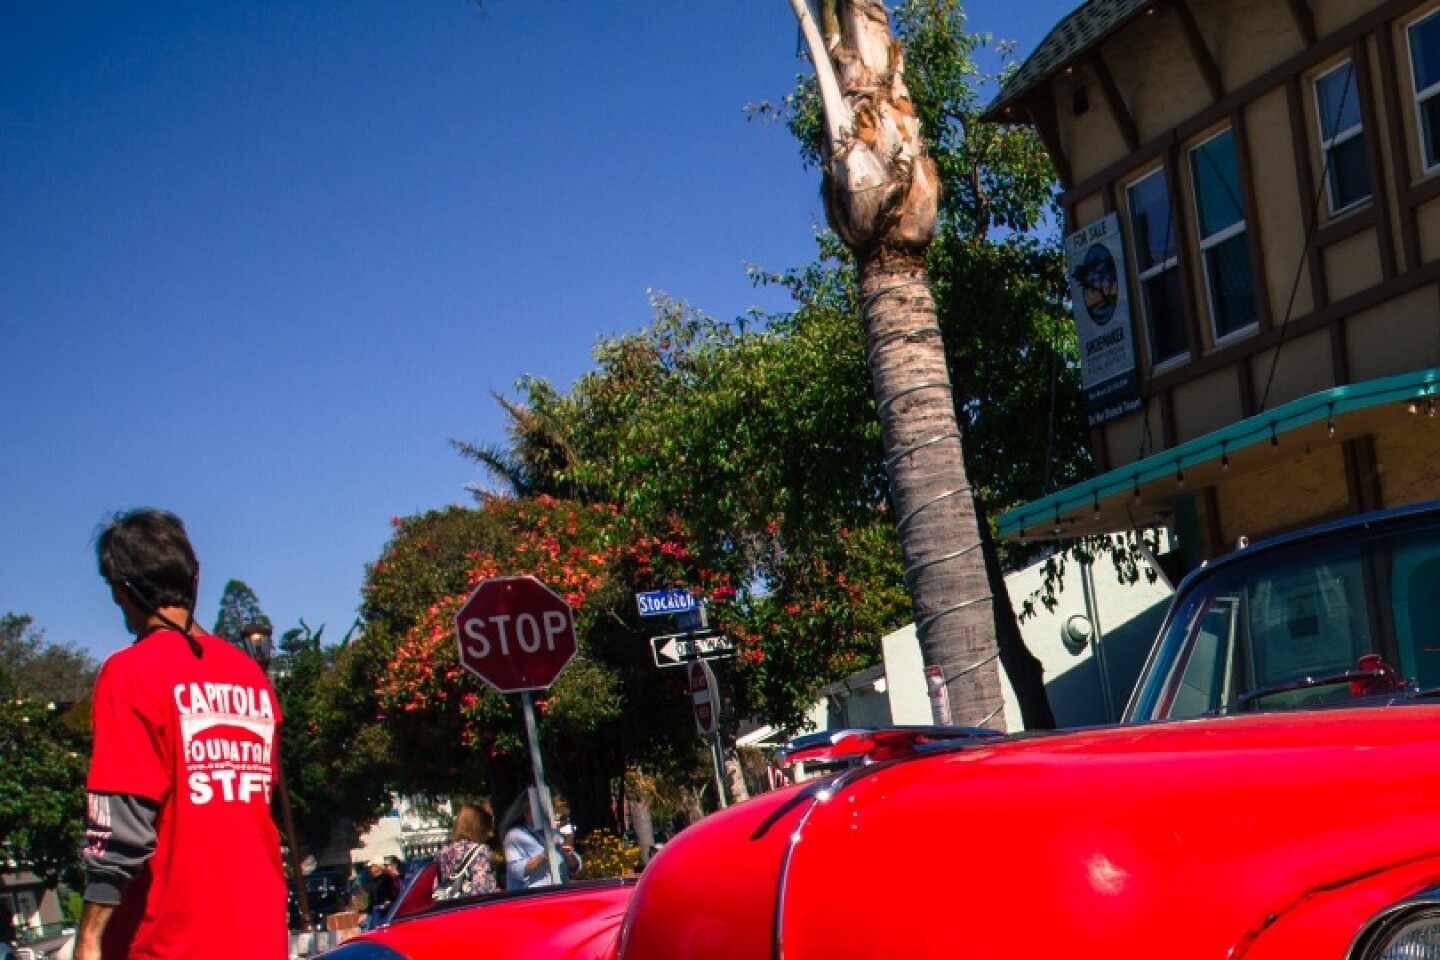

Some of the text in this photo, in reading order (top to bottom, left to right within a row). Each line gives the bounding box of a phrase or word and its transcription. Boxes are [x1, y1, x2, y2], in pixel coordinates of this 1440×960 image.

[1073, 220, 1107, 249] FOR SALE
[1085, 326, 1124, 351] SHOEMAKER
[464, 610, 568, 659] STOP
[174, 682, 273, 718] CAPITOLA
